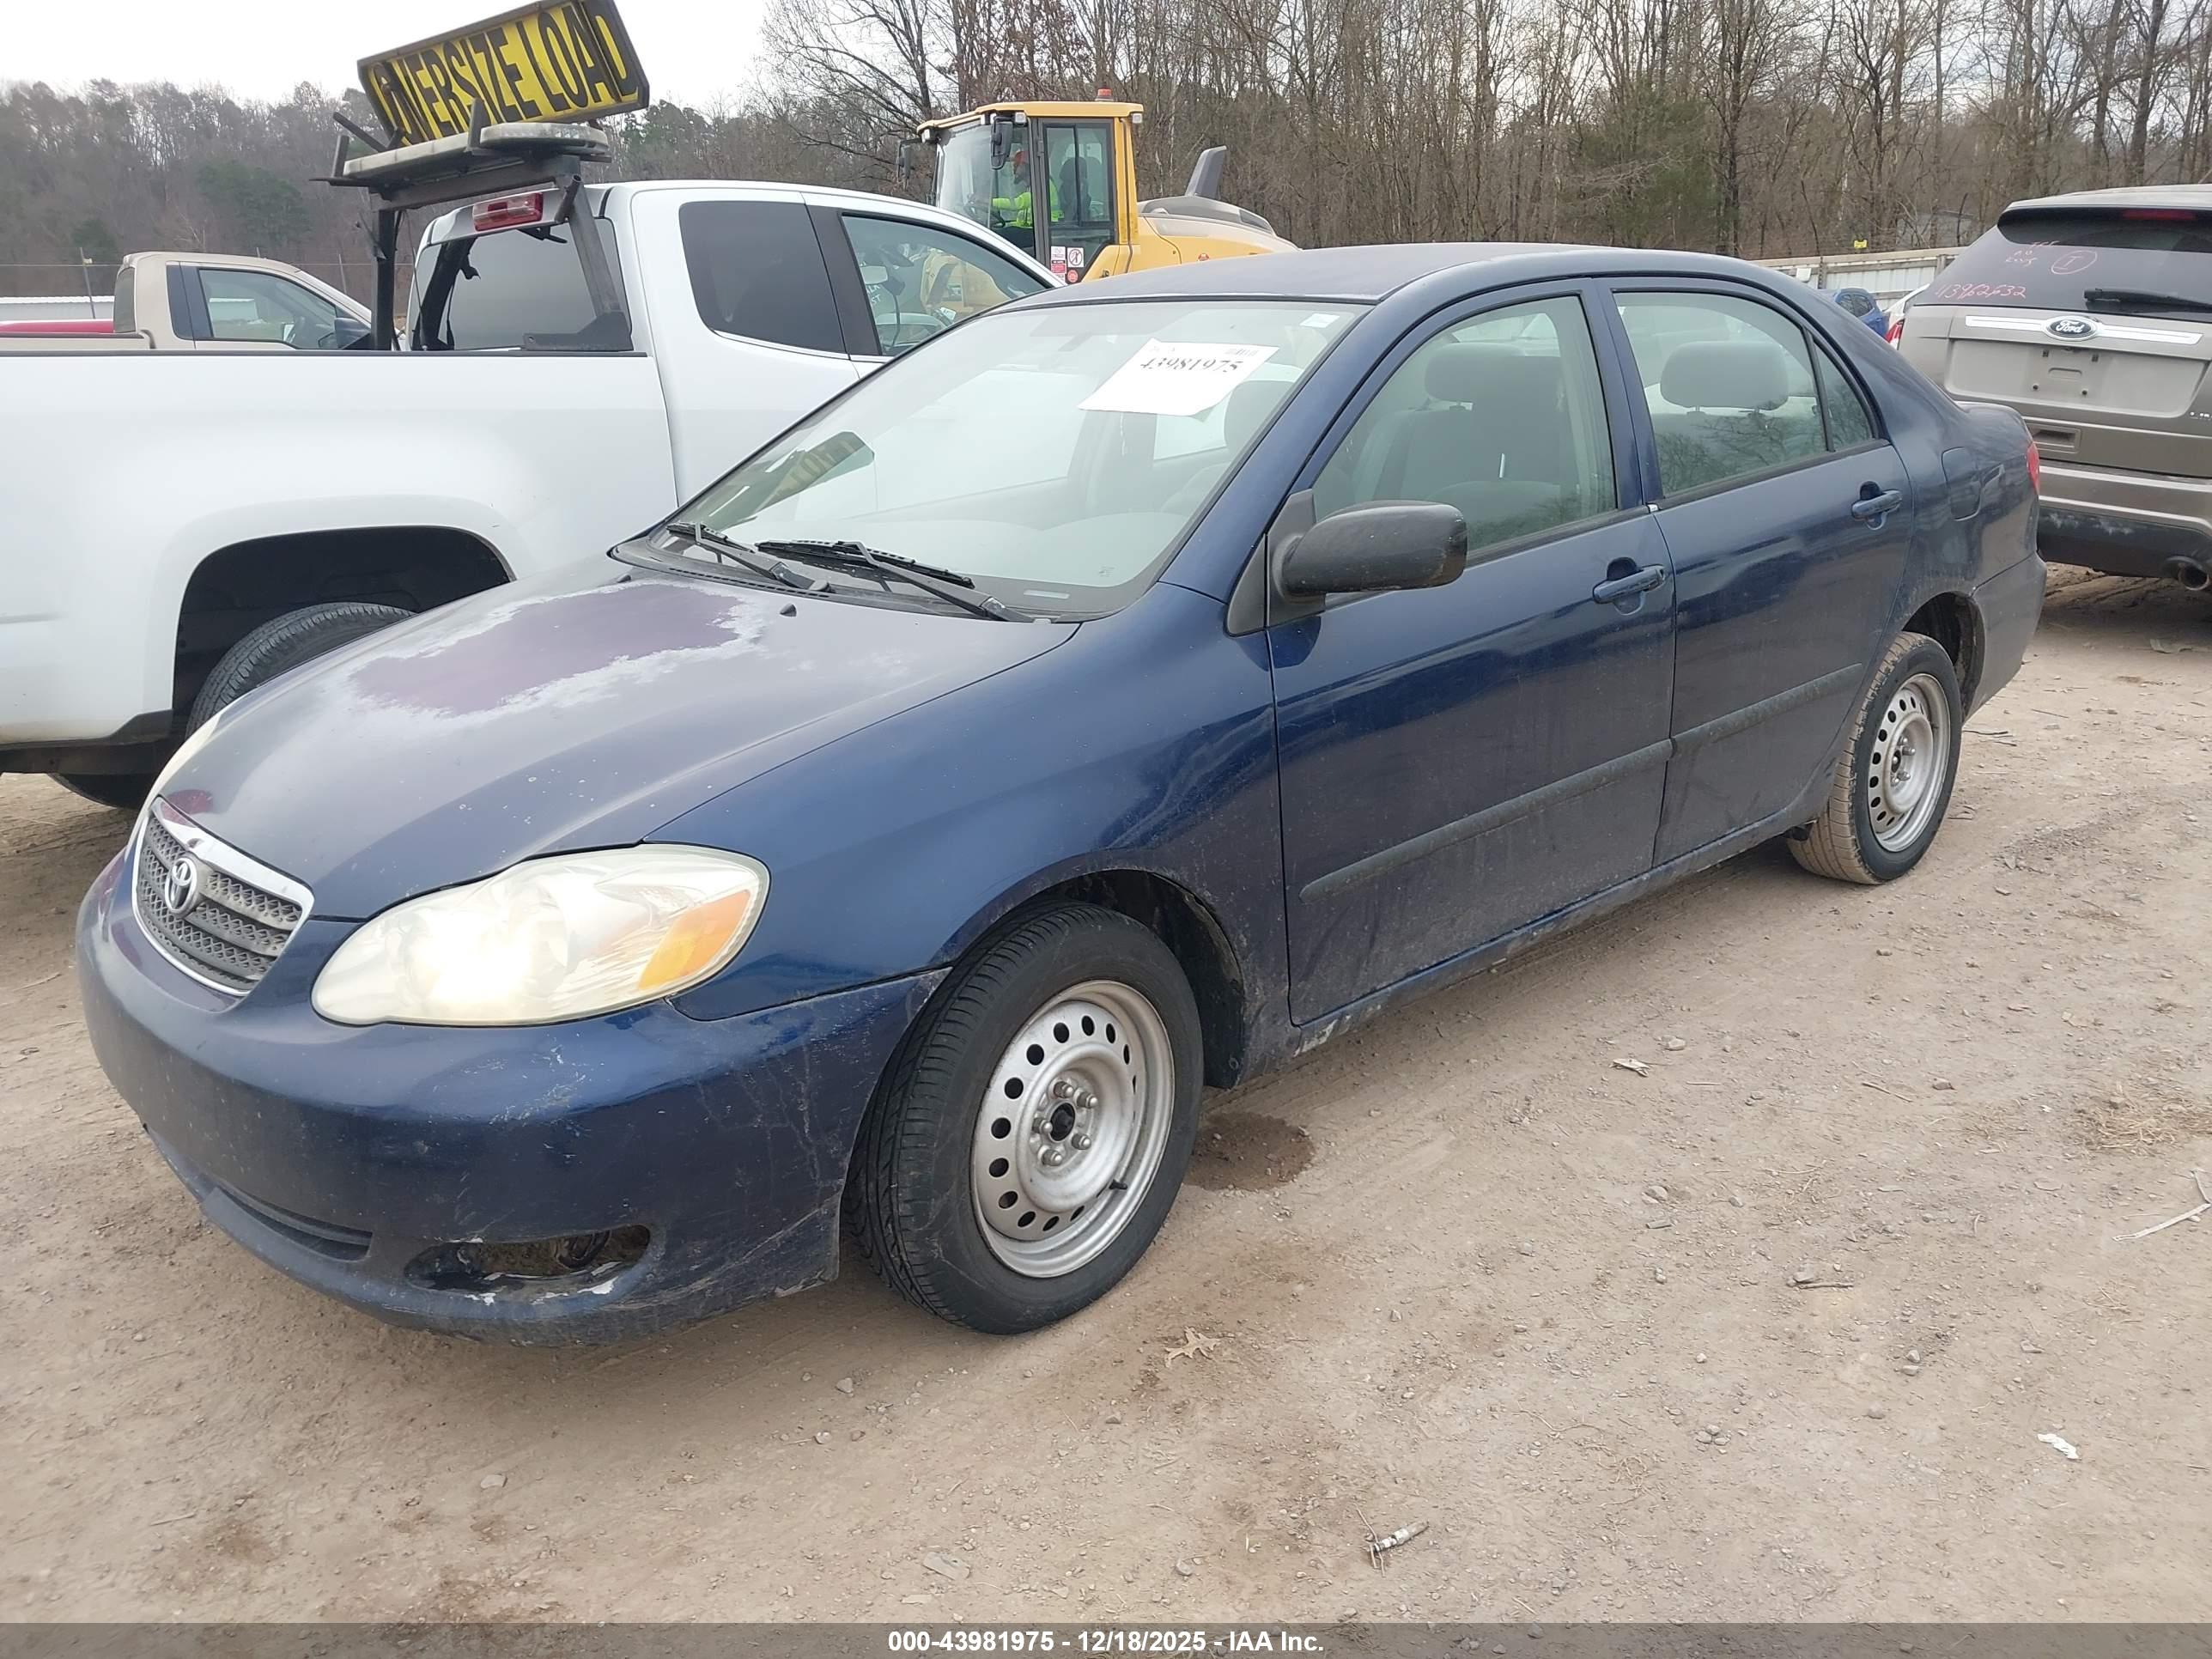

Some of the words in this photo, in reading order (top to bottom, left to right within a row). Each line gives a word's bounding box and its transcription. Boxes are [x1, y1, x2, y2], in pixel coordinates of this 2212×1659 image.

[371, 26, 544, 144] OVERSIZE
[514, 0, 639, 113] LOAD
[2055, 320, 2085, 333] Ford
[1140, 357, 1244, 373] 43981975
